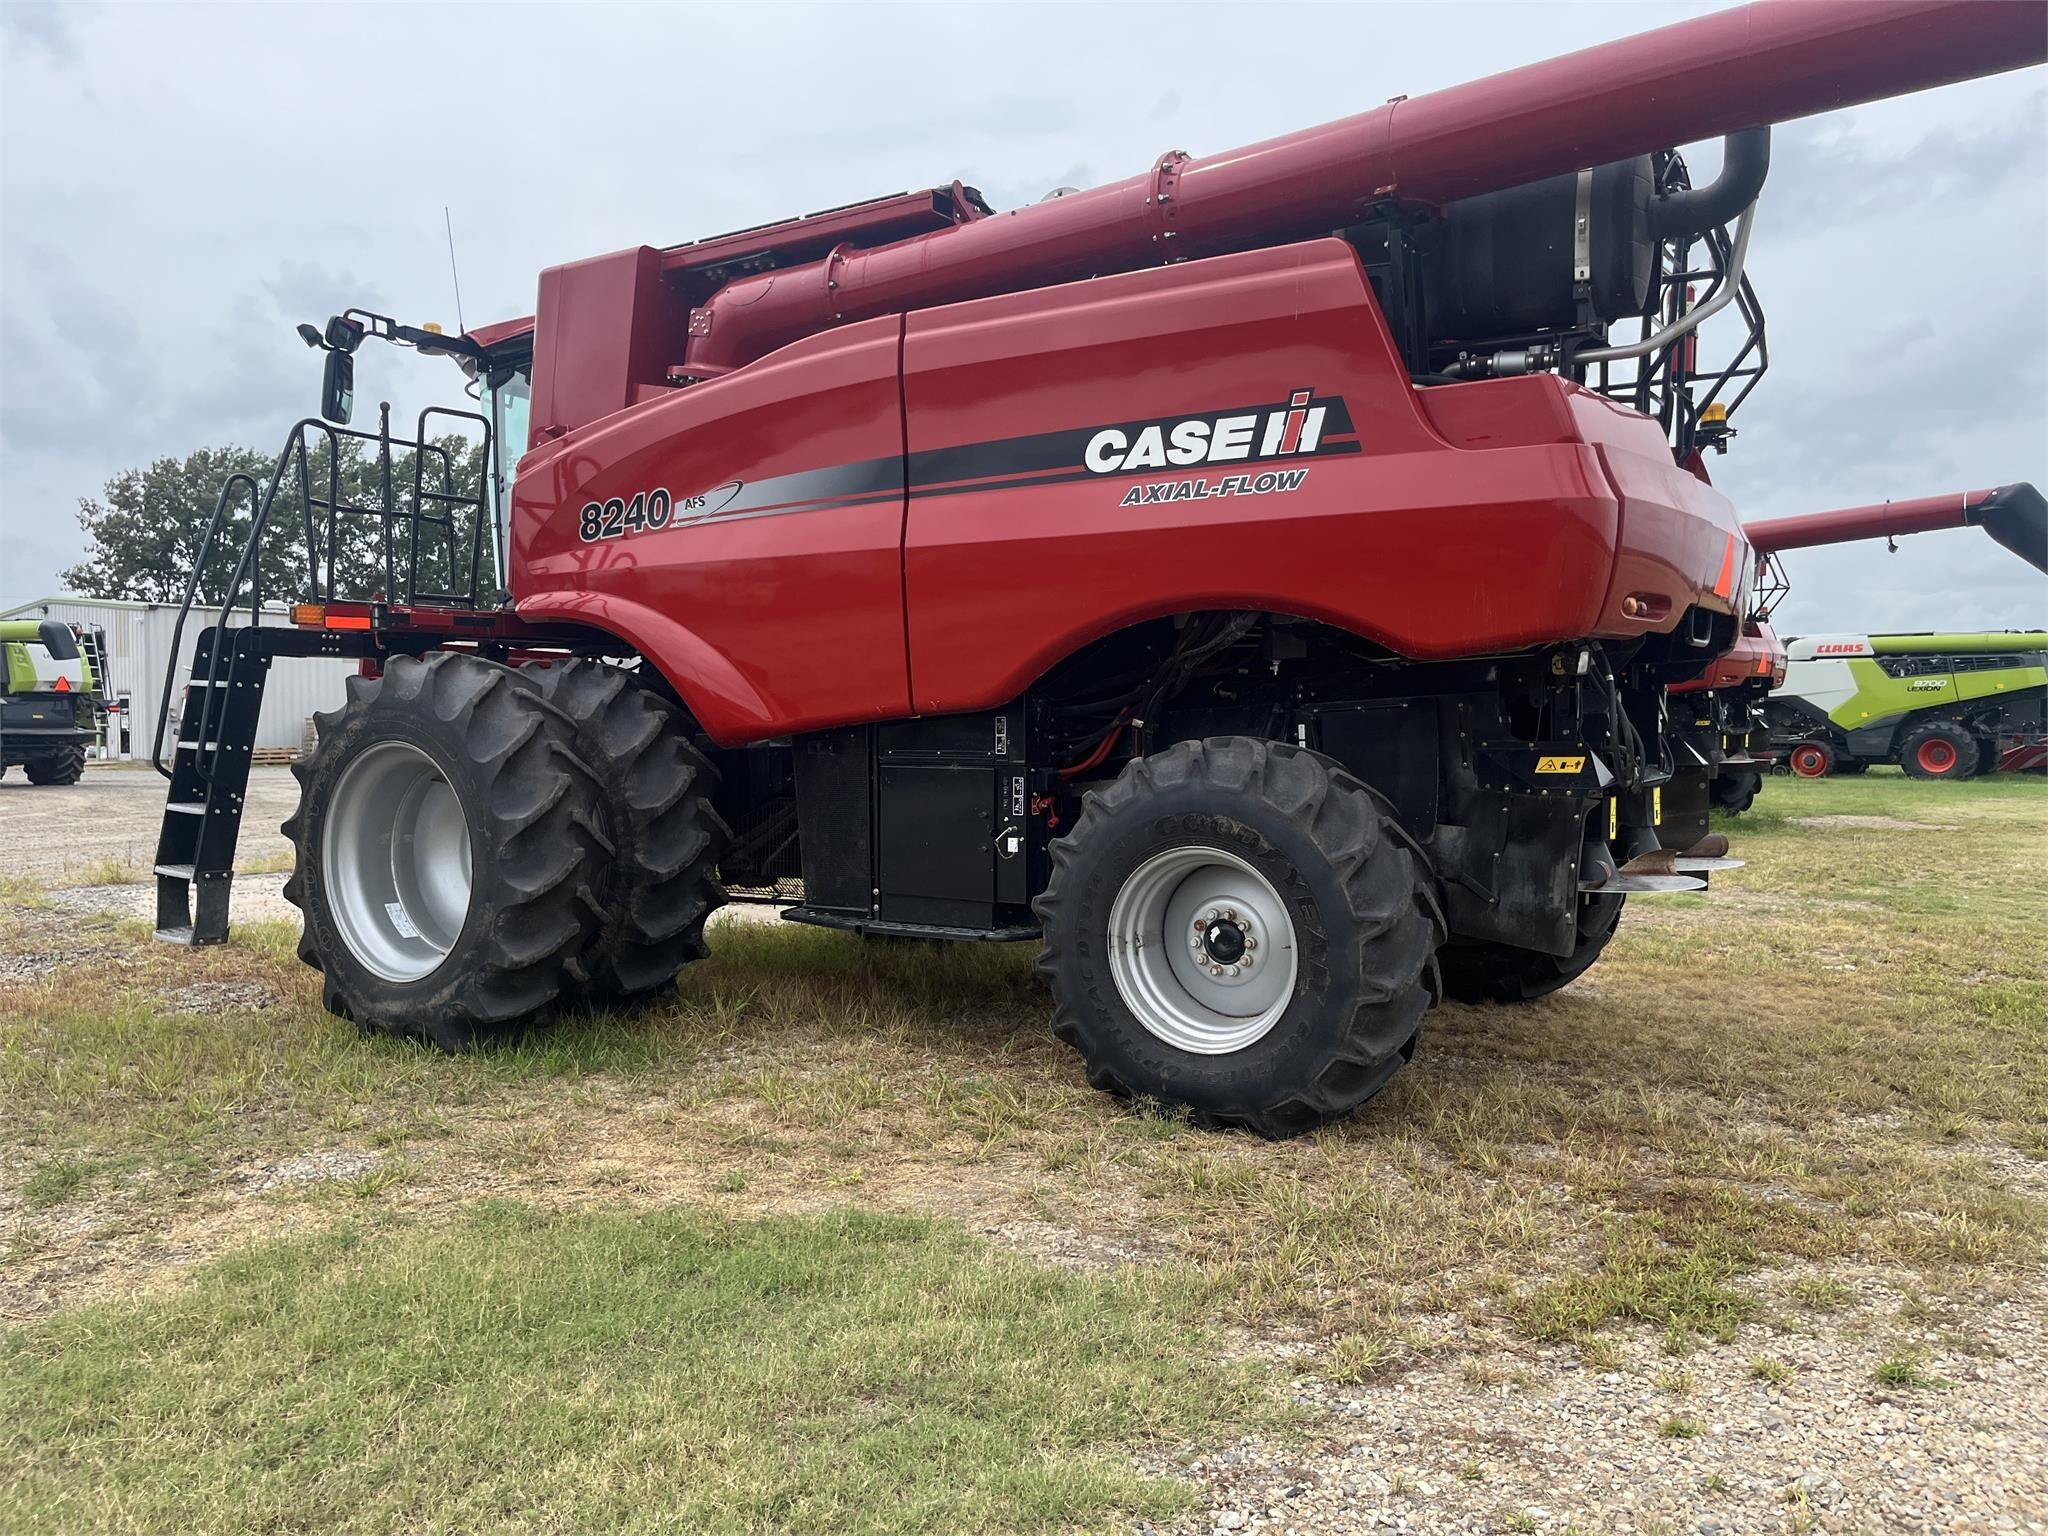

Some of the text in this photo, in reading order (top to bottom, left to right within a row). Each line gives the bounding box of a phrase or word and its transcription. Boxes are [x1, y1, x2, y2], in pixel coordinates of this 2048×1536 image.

[1084, 414, 1258, 474] CASE
[1118, 467, 1311, 508] AXIAL-FLOW
[578, 486, 706, 543] 8240 AFS
[1816, 643, 1864, 654] CLAAS
